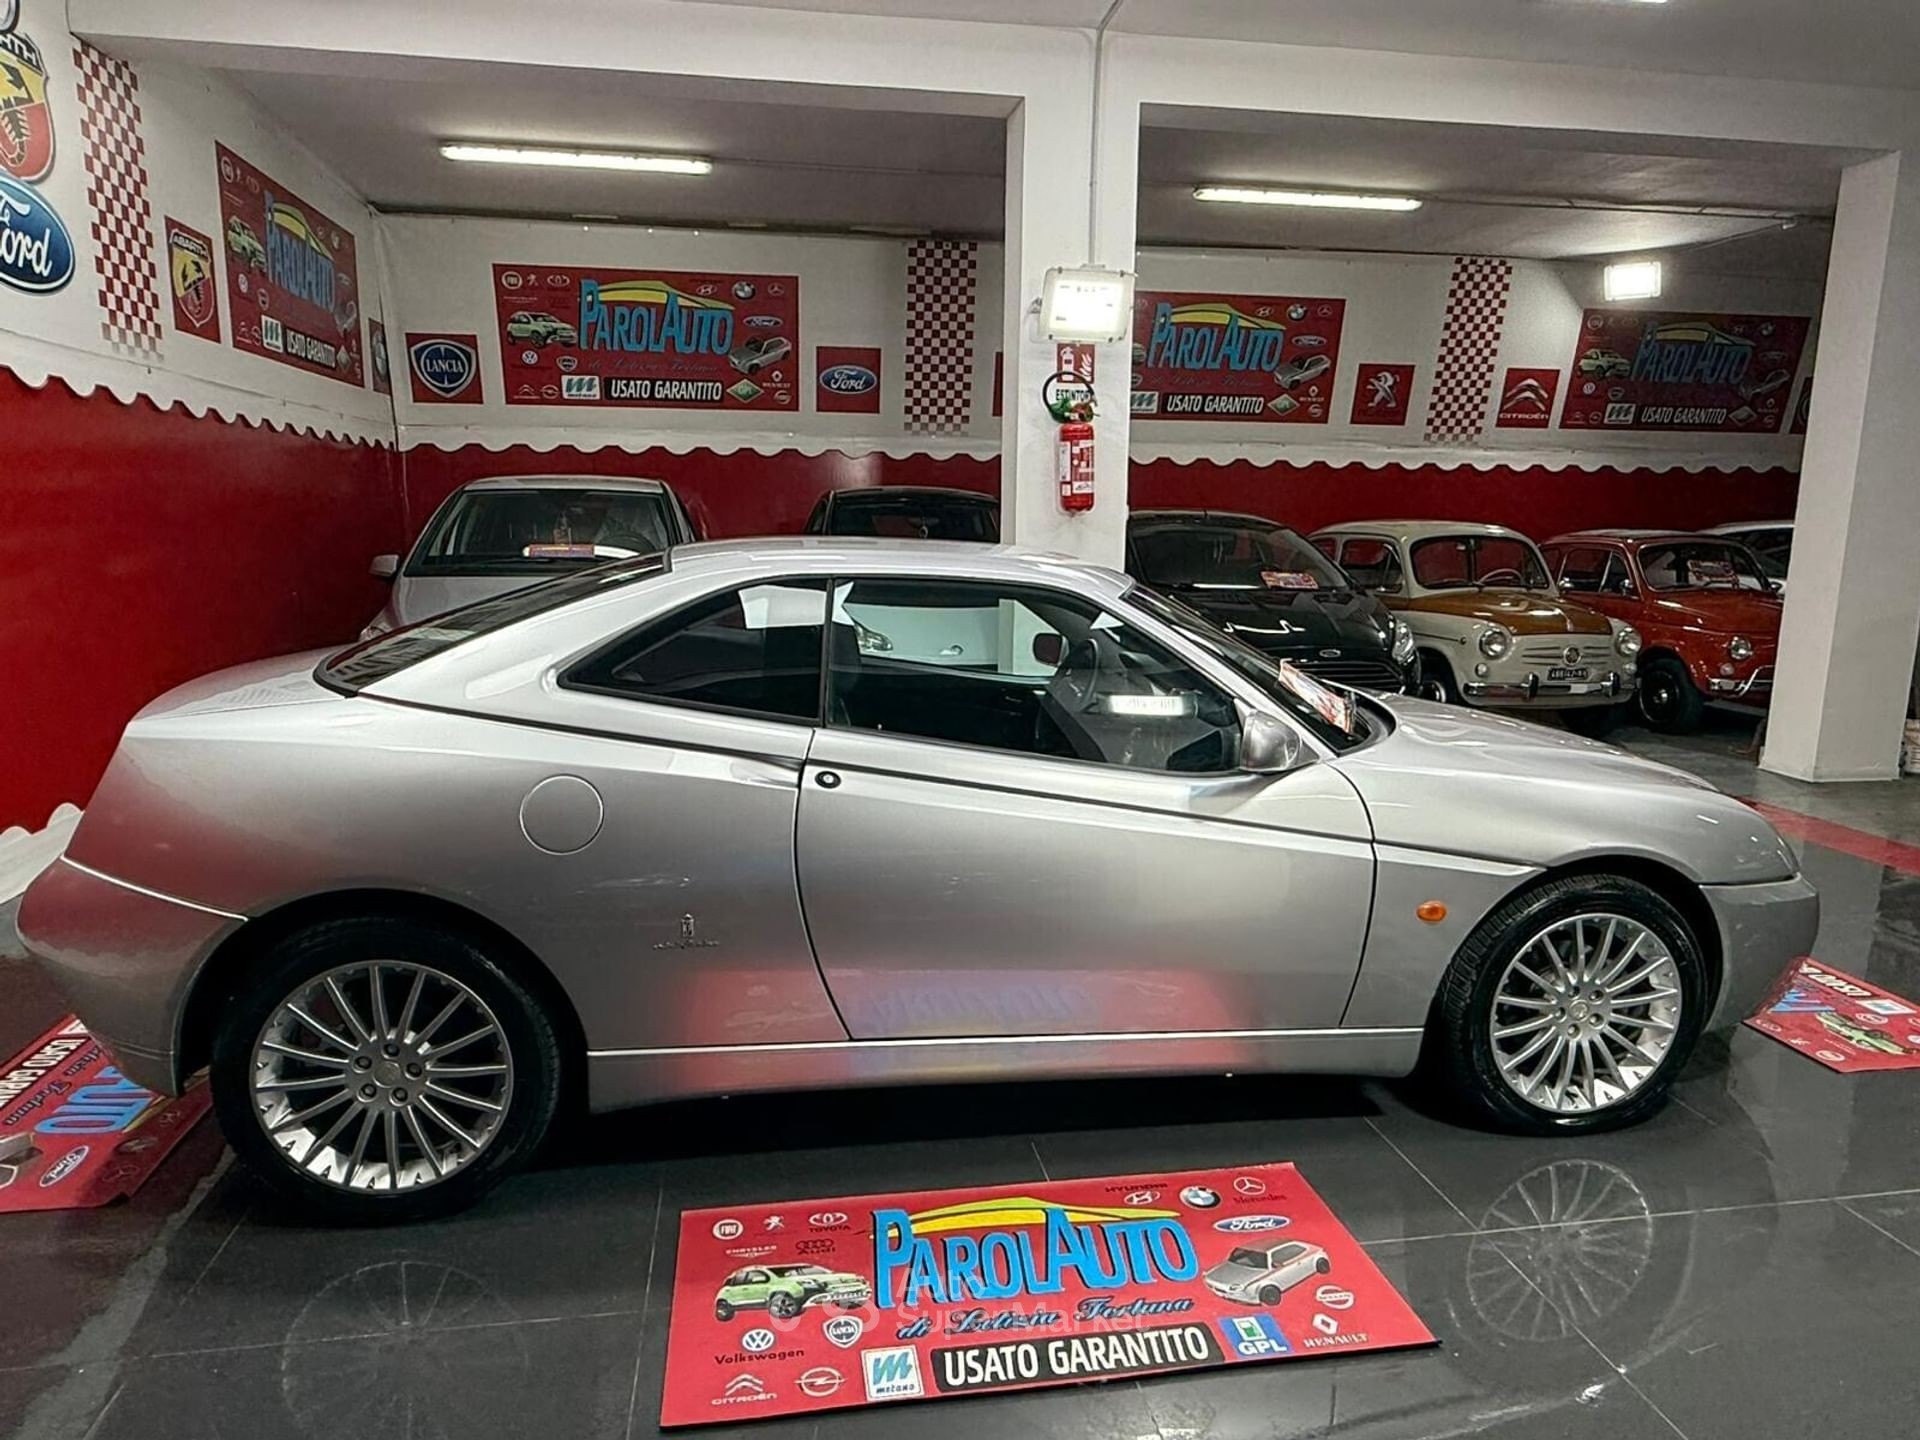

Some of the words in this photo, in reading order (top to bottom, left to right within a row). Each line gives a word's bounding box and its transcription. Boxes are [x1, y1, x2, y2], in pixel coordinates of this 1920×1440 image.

[579, 278, 734, 355] PAROLAUTO
[1147, 302, 1285, 373] PAROLAUTO
[426, 359, 464, 373] LANCIA
[611, 379, 651, 398] USATO
[654, 381, 722, 400] GARANTITO
[830, 369, 866, 390] Ford
[1166, 394, 1201, 412] USATO
[1203, 396, 1265, 414] GARANTITO
[1641, 406, 1673, 424] USATO
[1673, 407, 1727, 425] GARANTITO
[809, 1225, 851, 1233] TOYOTA
[1230, 1216, 1276, 1230] Ford
[873, 1207, 1199, 1310] PAROLAUTO
[1074, 1296, 1195, 1322] Fortuna
[1238, 1339, 1288, 1356] GPL
[1303, 1333, 1369, 1348] RENAULT
[714, 1350, 805, 1365] Volkswagen
[944, 1343, 1039, 1387] USATO
[1048, 1326, 1209, 1376] GARANTITO
